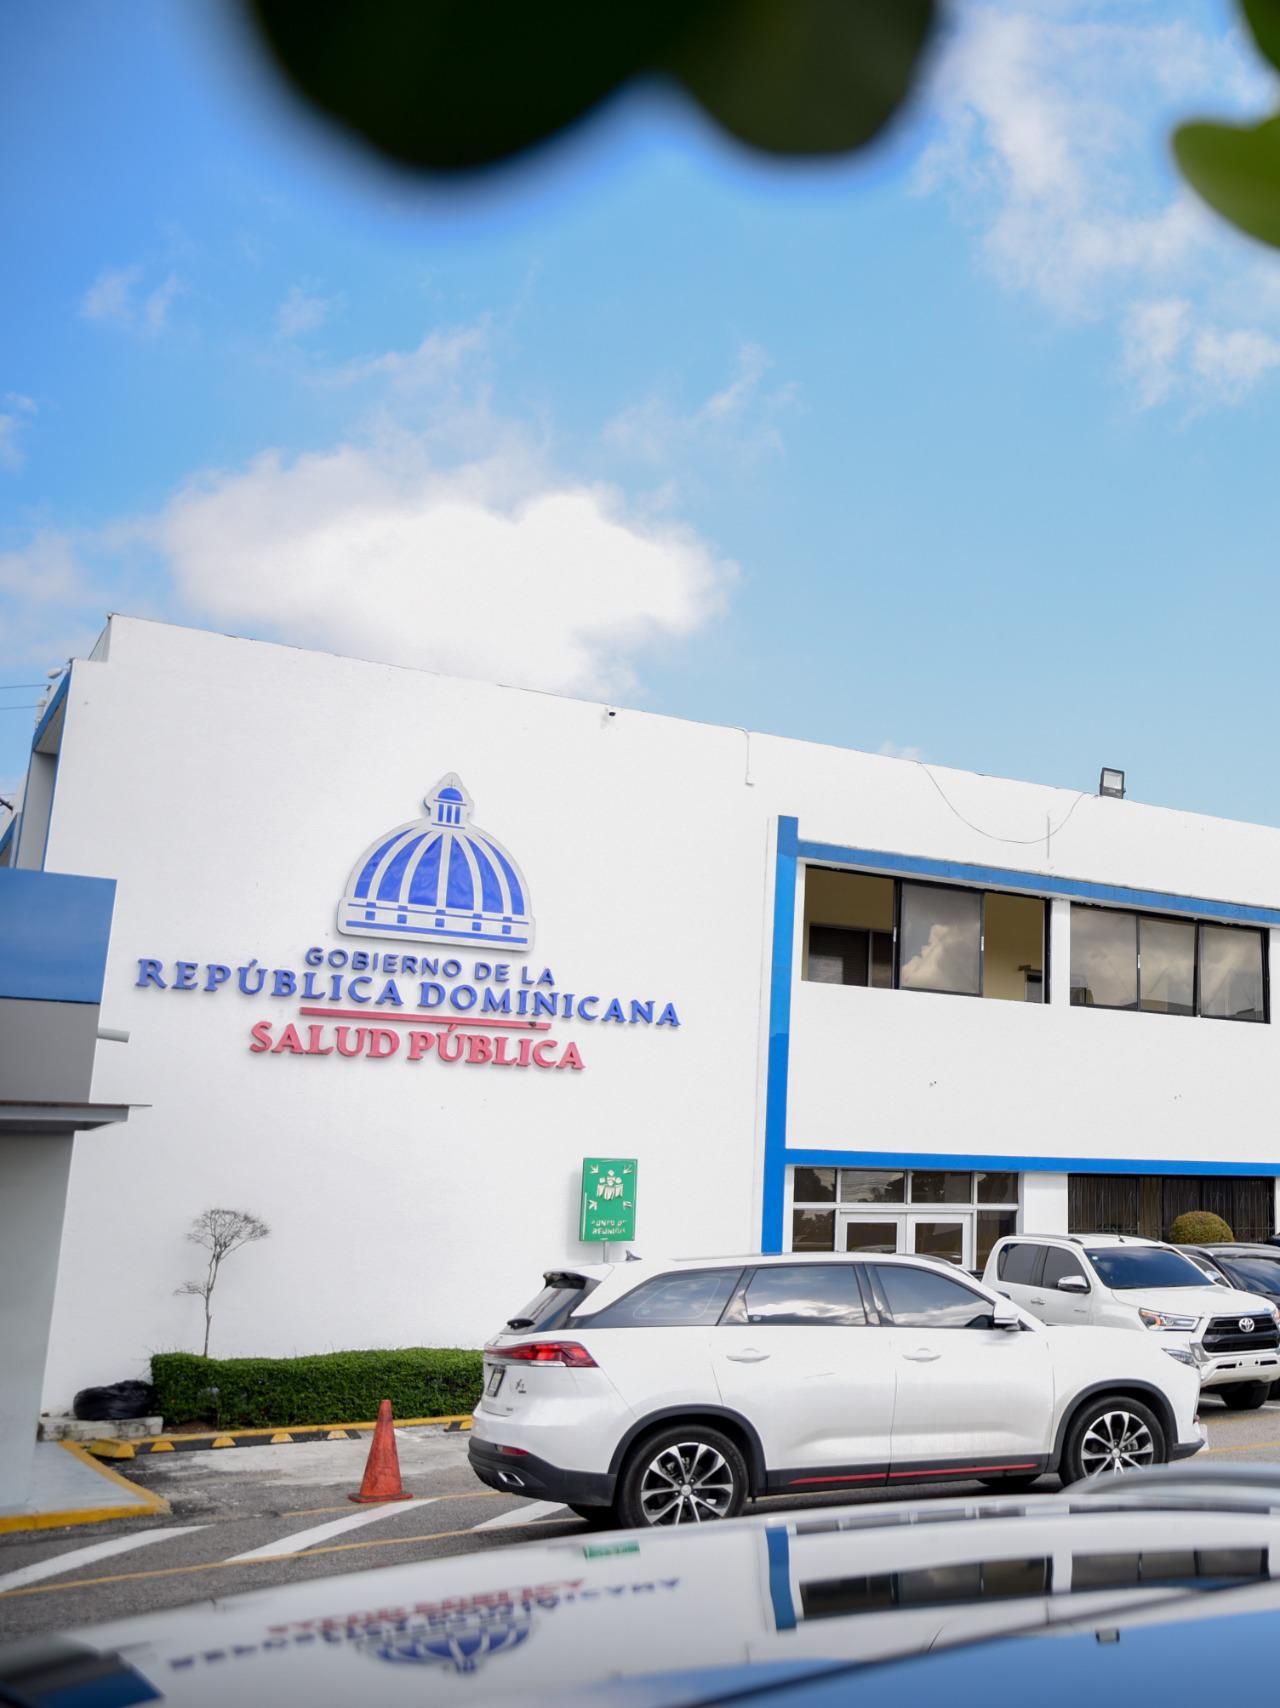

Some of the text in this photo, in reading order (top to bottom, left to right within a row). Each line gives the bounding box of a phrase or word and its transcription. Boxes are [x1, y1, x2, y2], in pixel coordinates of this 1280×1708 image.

[304, 947, 556, 986] GOBIERNO DE LA
[135, 959, 681, 1027] REPÚBLICA DOMINICANA
[250, 1021, 586, 1070] SALUD PÚBLICA
